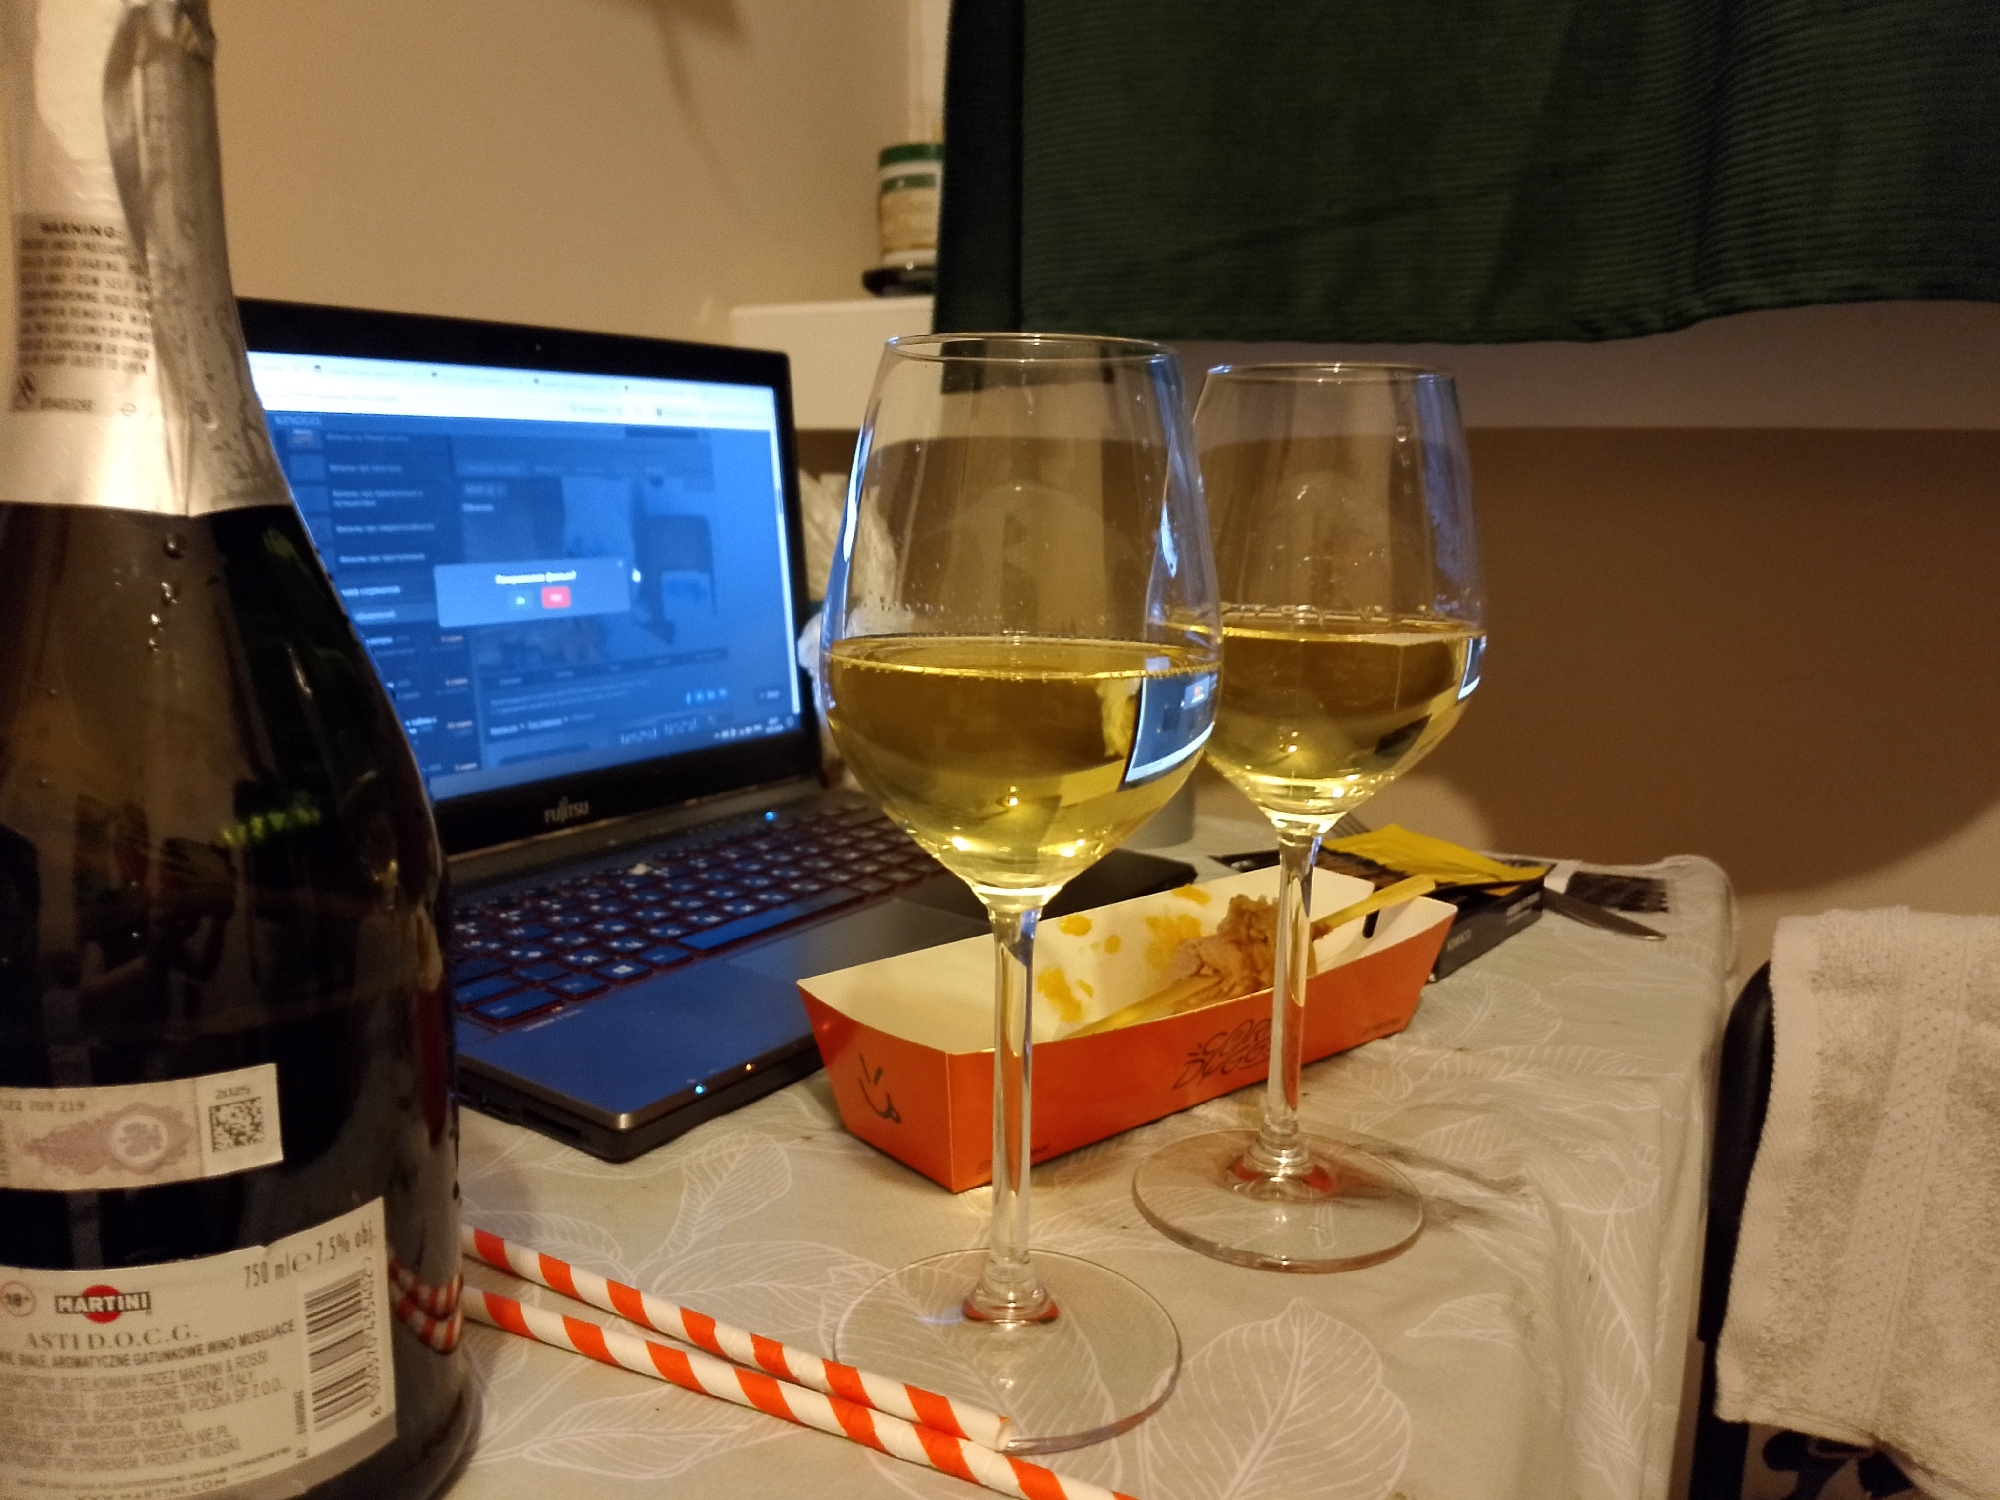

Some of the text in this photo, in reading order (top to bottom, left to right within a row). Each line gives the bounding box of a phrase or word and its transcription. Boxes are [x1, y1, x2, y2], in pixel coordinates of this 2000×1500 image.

[545, 800, 589, 824] FUJITSU
[244, 1261, 268, 1288] 750
[275, 1252, 291, 1281] ml
[57, 1292, 149, 1314] MARTINI
[25, 1323, 199, 1350] ASTI D.O.C.G.
[179, 1362, 222, 1381] MARTINI
[235, 1350, 268, 1369] ROSSI
